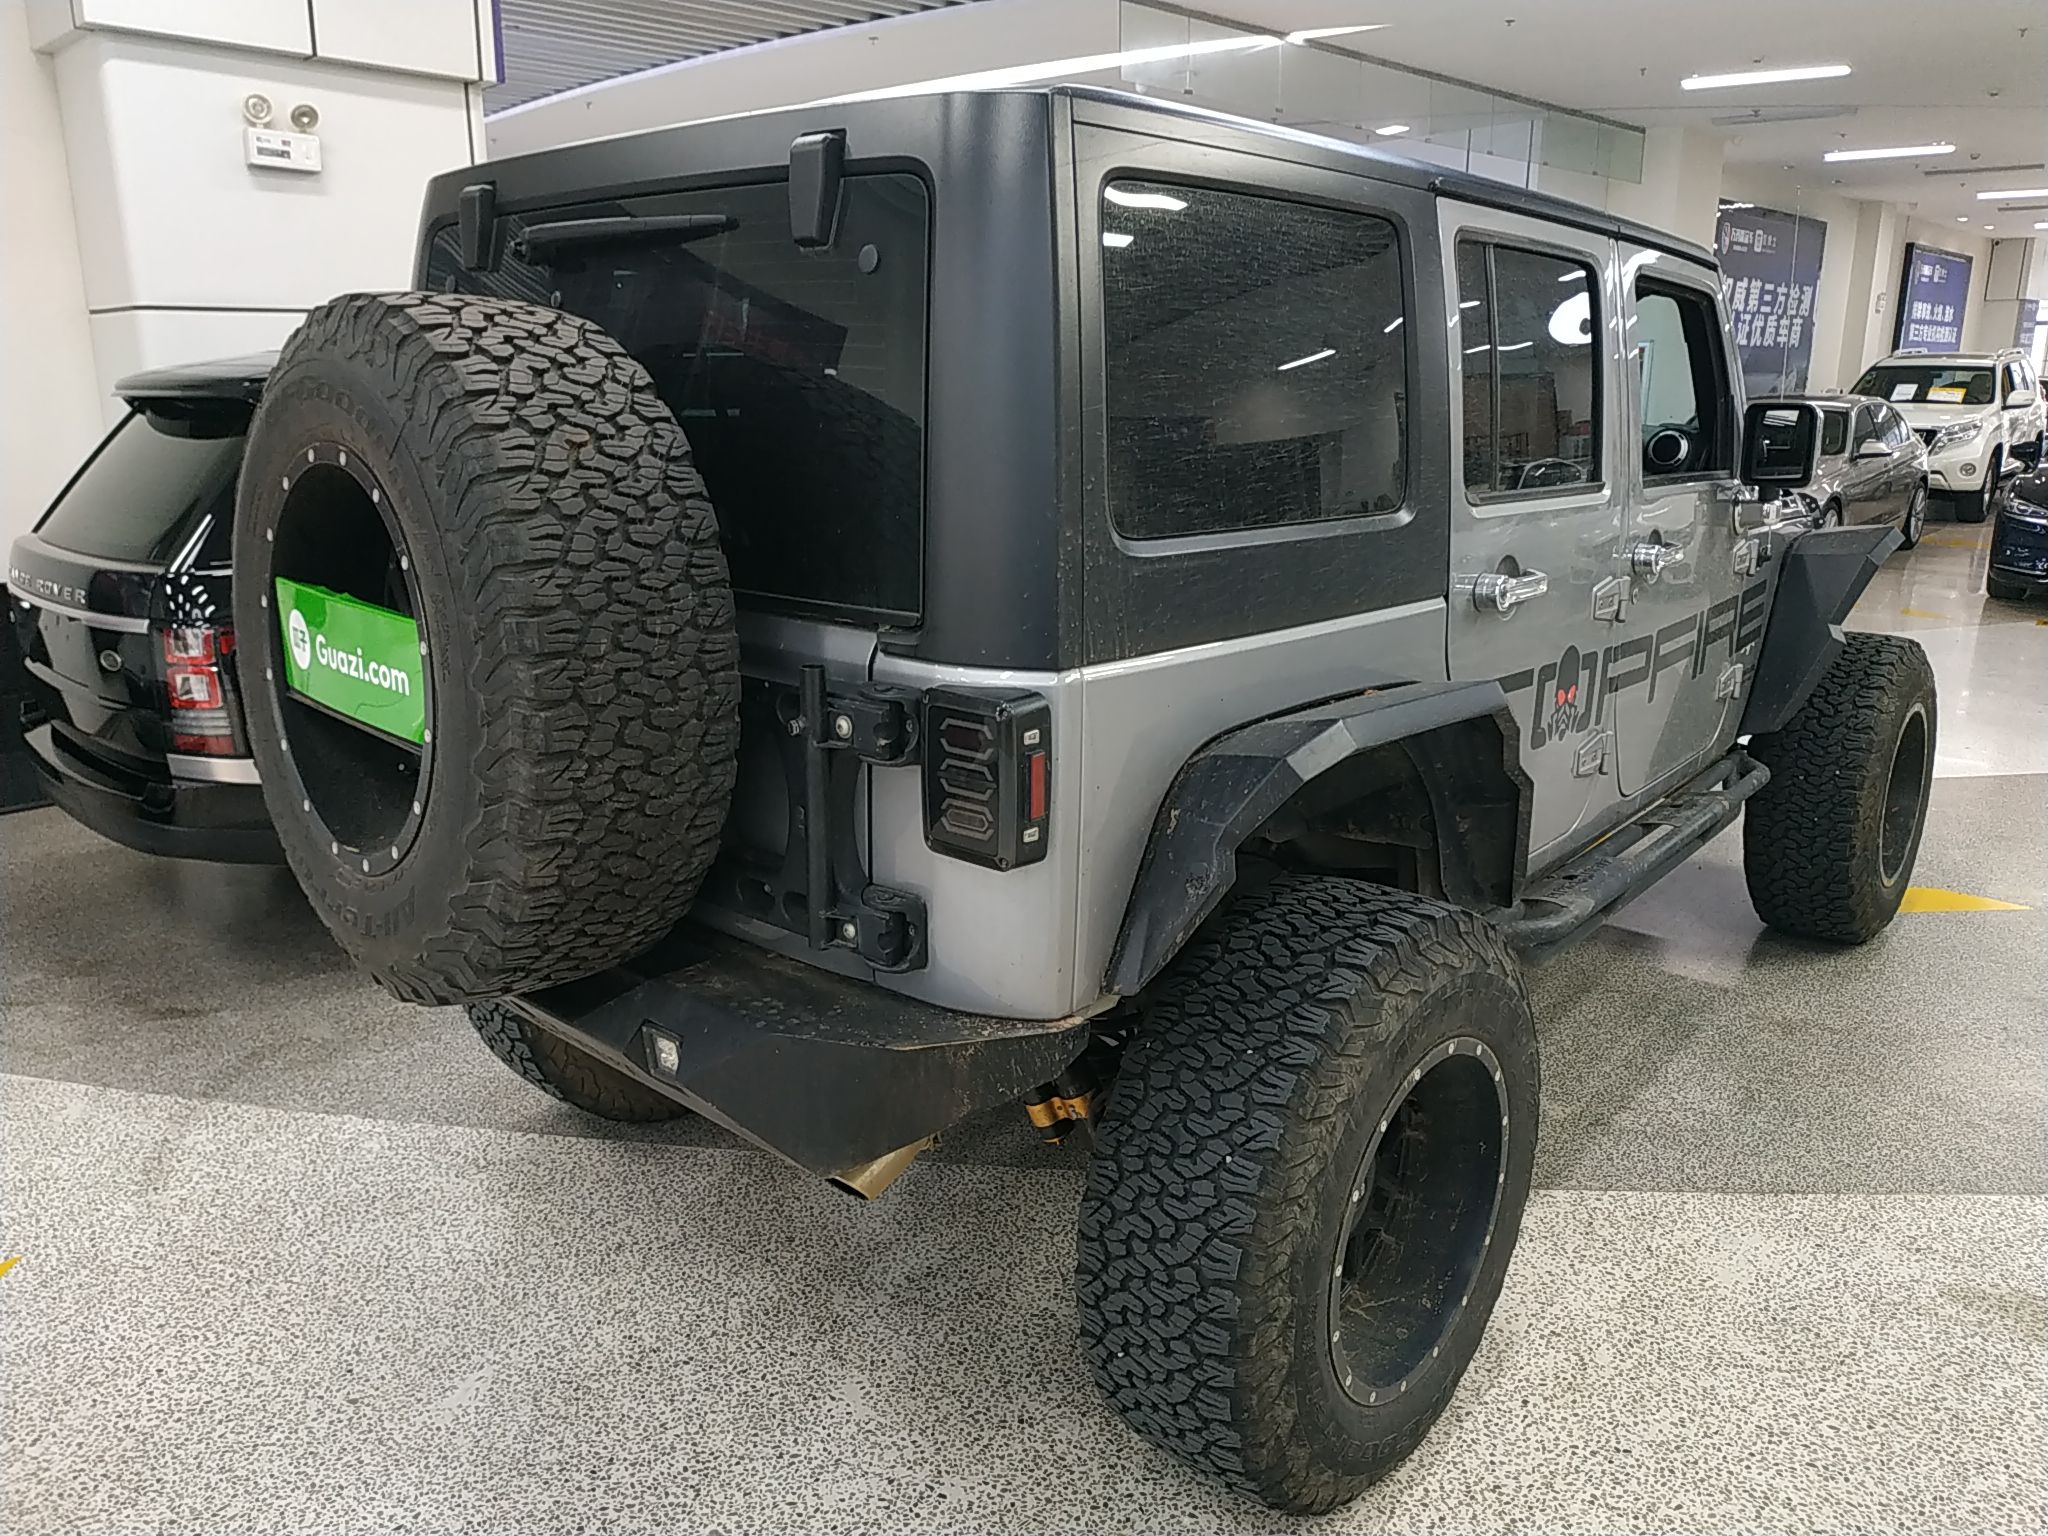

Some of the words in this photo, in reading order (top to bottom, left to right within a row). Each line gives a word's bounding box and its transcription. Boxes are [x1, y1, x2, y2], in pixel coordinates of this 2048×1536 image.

[1732, 312, 1804, 348] 证优质车商
[36, 578, 87, 604] ROVER
[315, 634, 410, 696] Guazi.com
